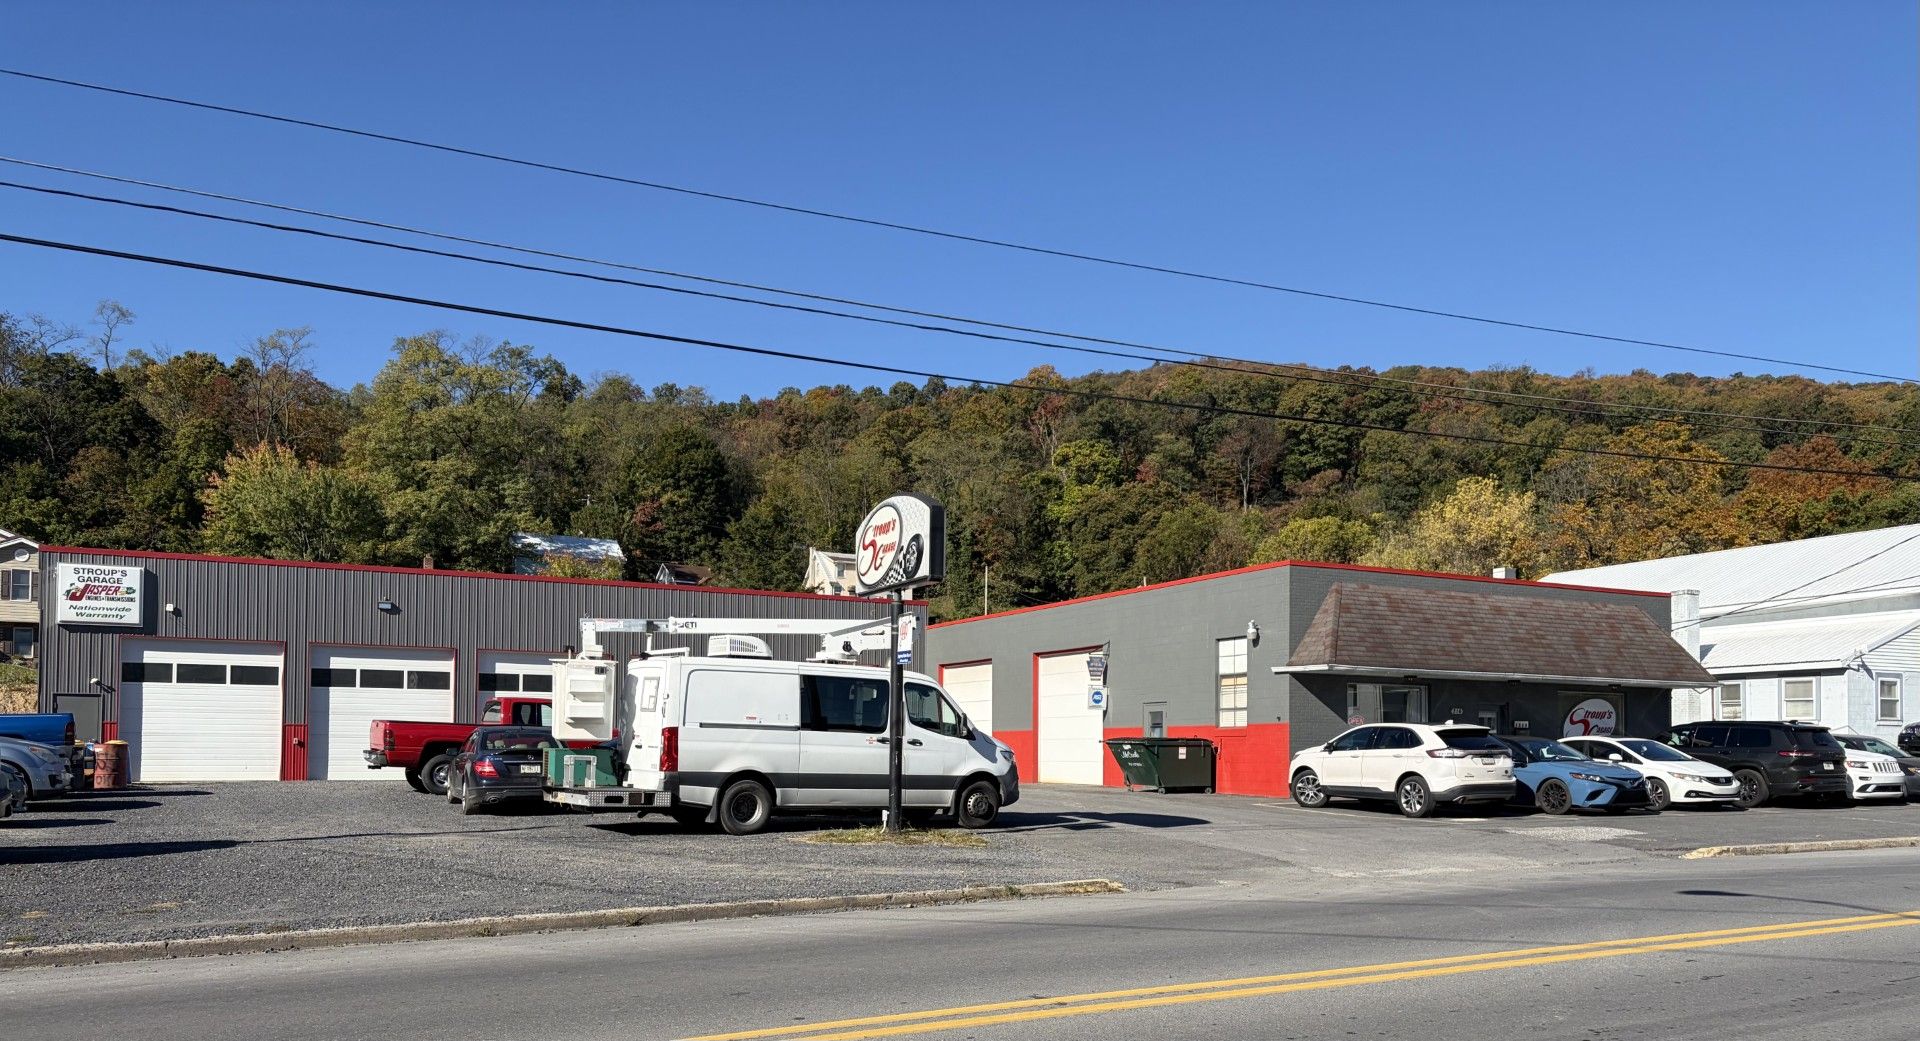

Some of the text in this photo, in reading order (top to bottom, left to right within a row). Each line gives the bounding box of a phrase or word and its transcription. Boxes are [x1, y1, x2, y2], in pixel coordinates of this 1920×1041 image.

[73, 567, 128, 577] STROUP'S
[77, 575, 124, 585] GARAGE
[68, 583, 121, 602] JASPER
[105, 595, 136, 603] TRANSMISSIONS
[68, 604, 132, 613] Nationwide
[75, 611, 126, 620] Warranty
